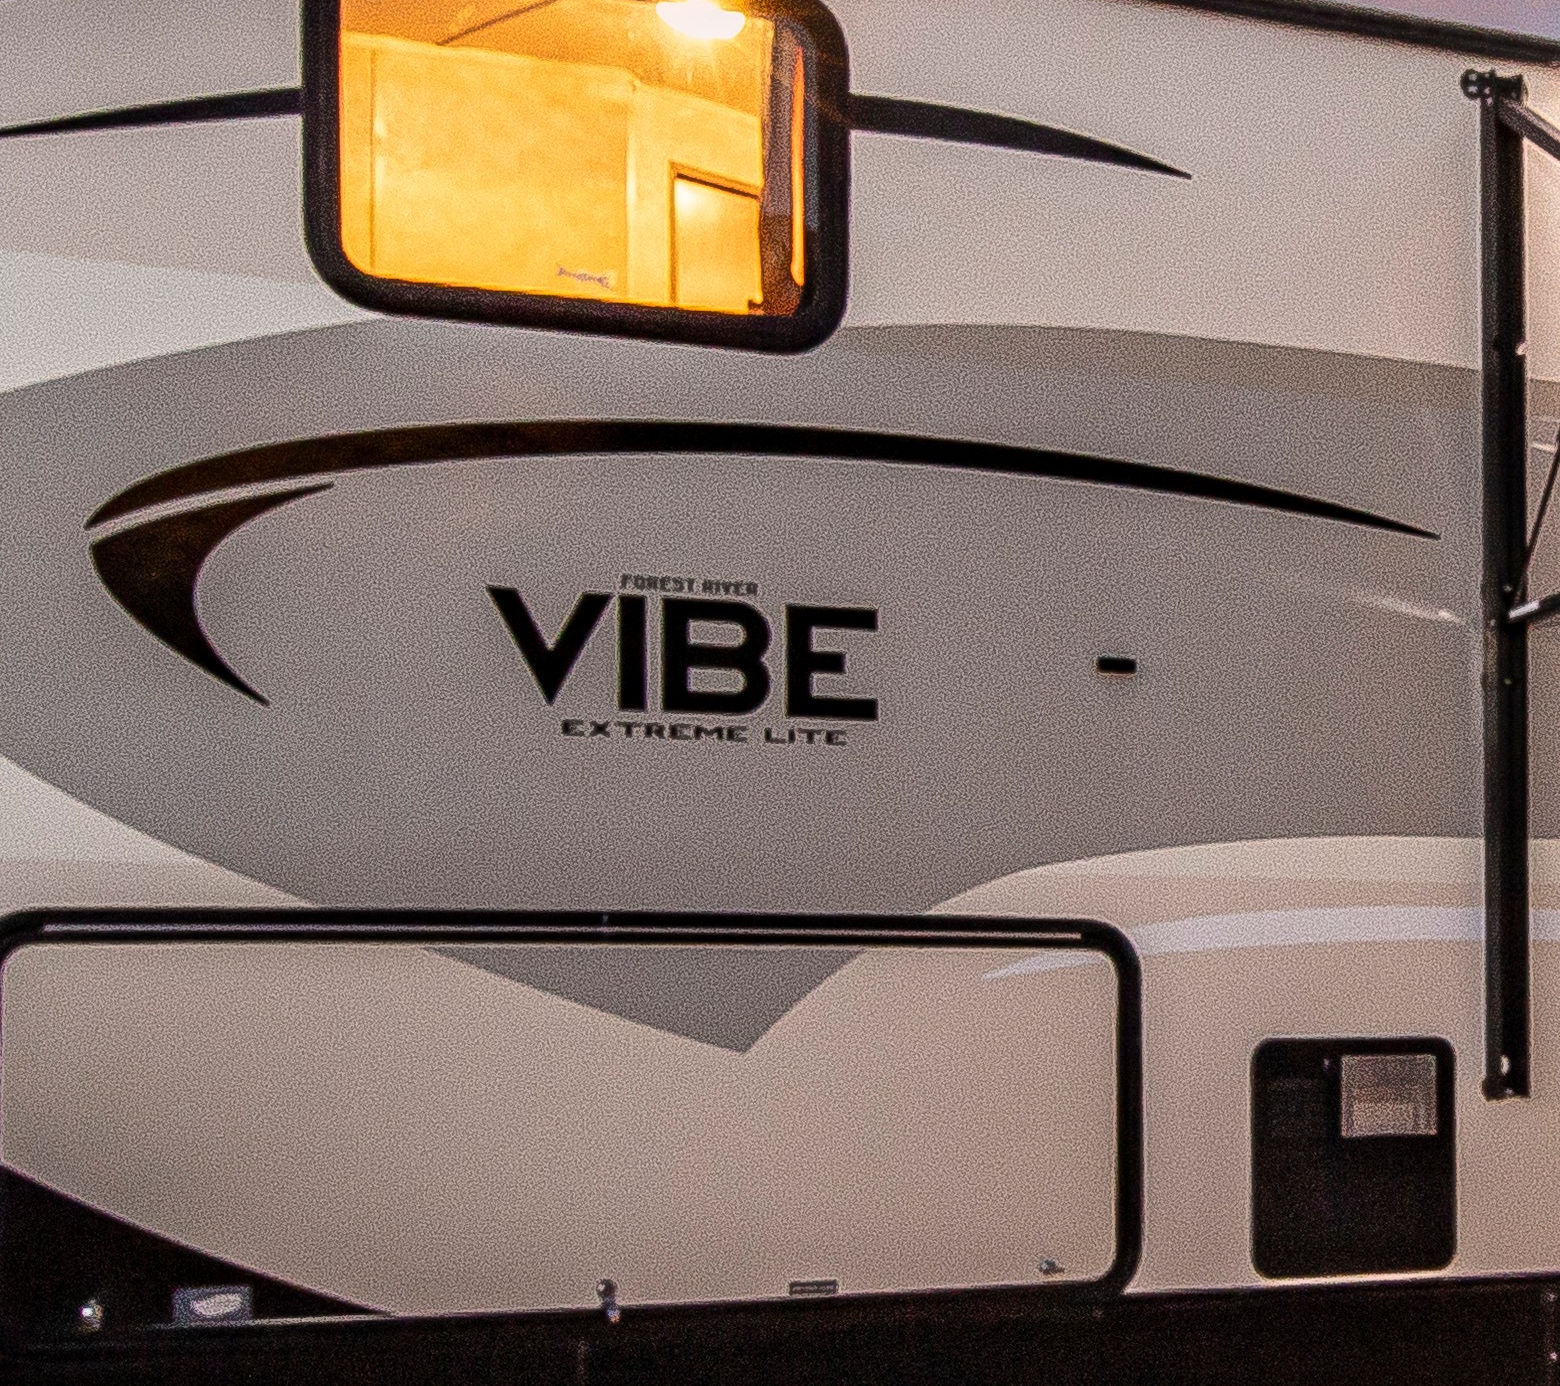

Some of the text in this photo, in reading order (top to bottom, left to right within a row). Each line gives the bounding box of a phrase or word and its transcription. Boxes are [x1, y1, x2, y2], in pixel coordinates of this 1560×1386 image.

[620, 573, 759, 596] FOREST RIVER
[486, 584, 880, 722] VIBE
[561, 718, 847, 746] EXTREME LITE
